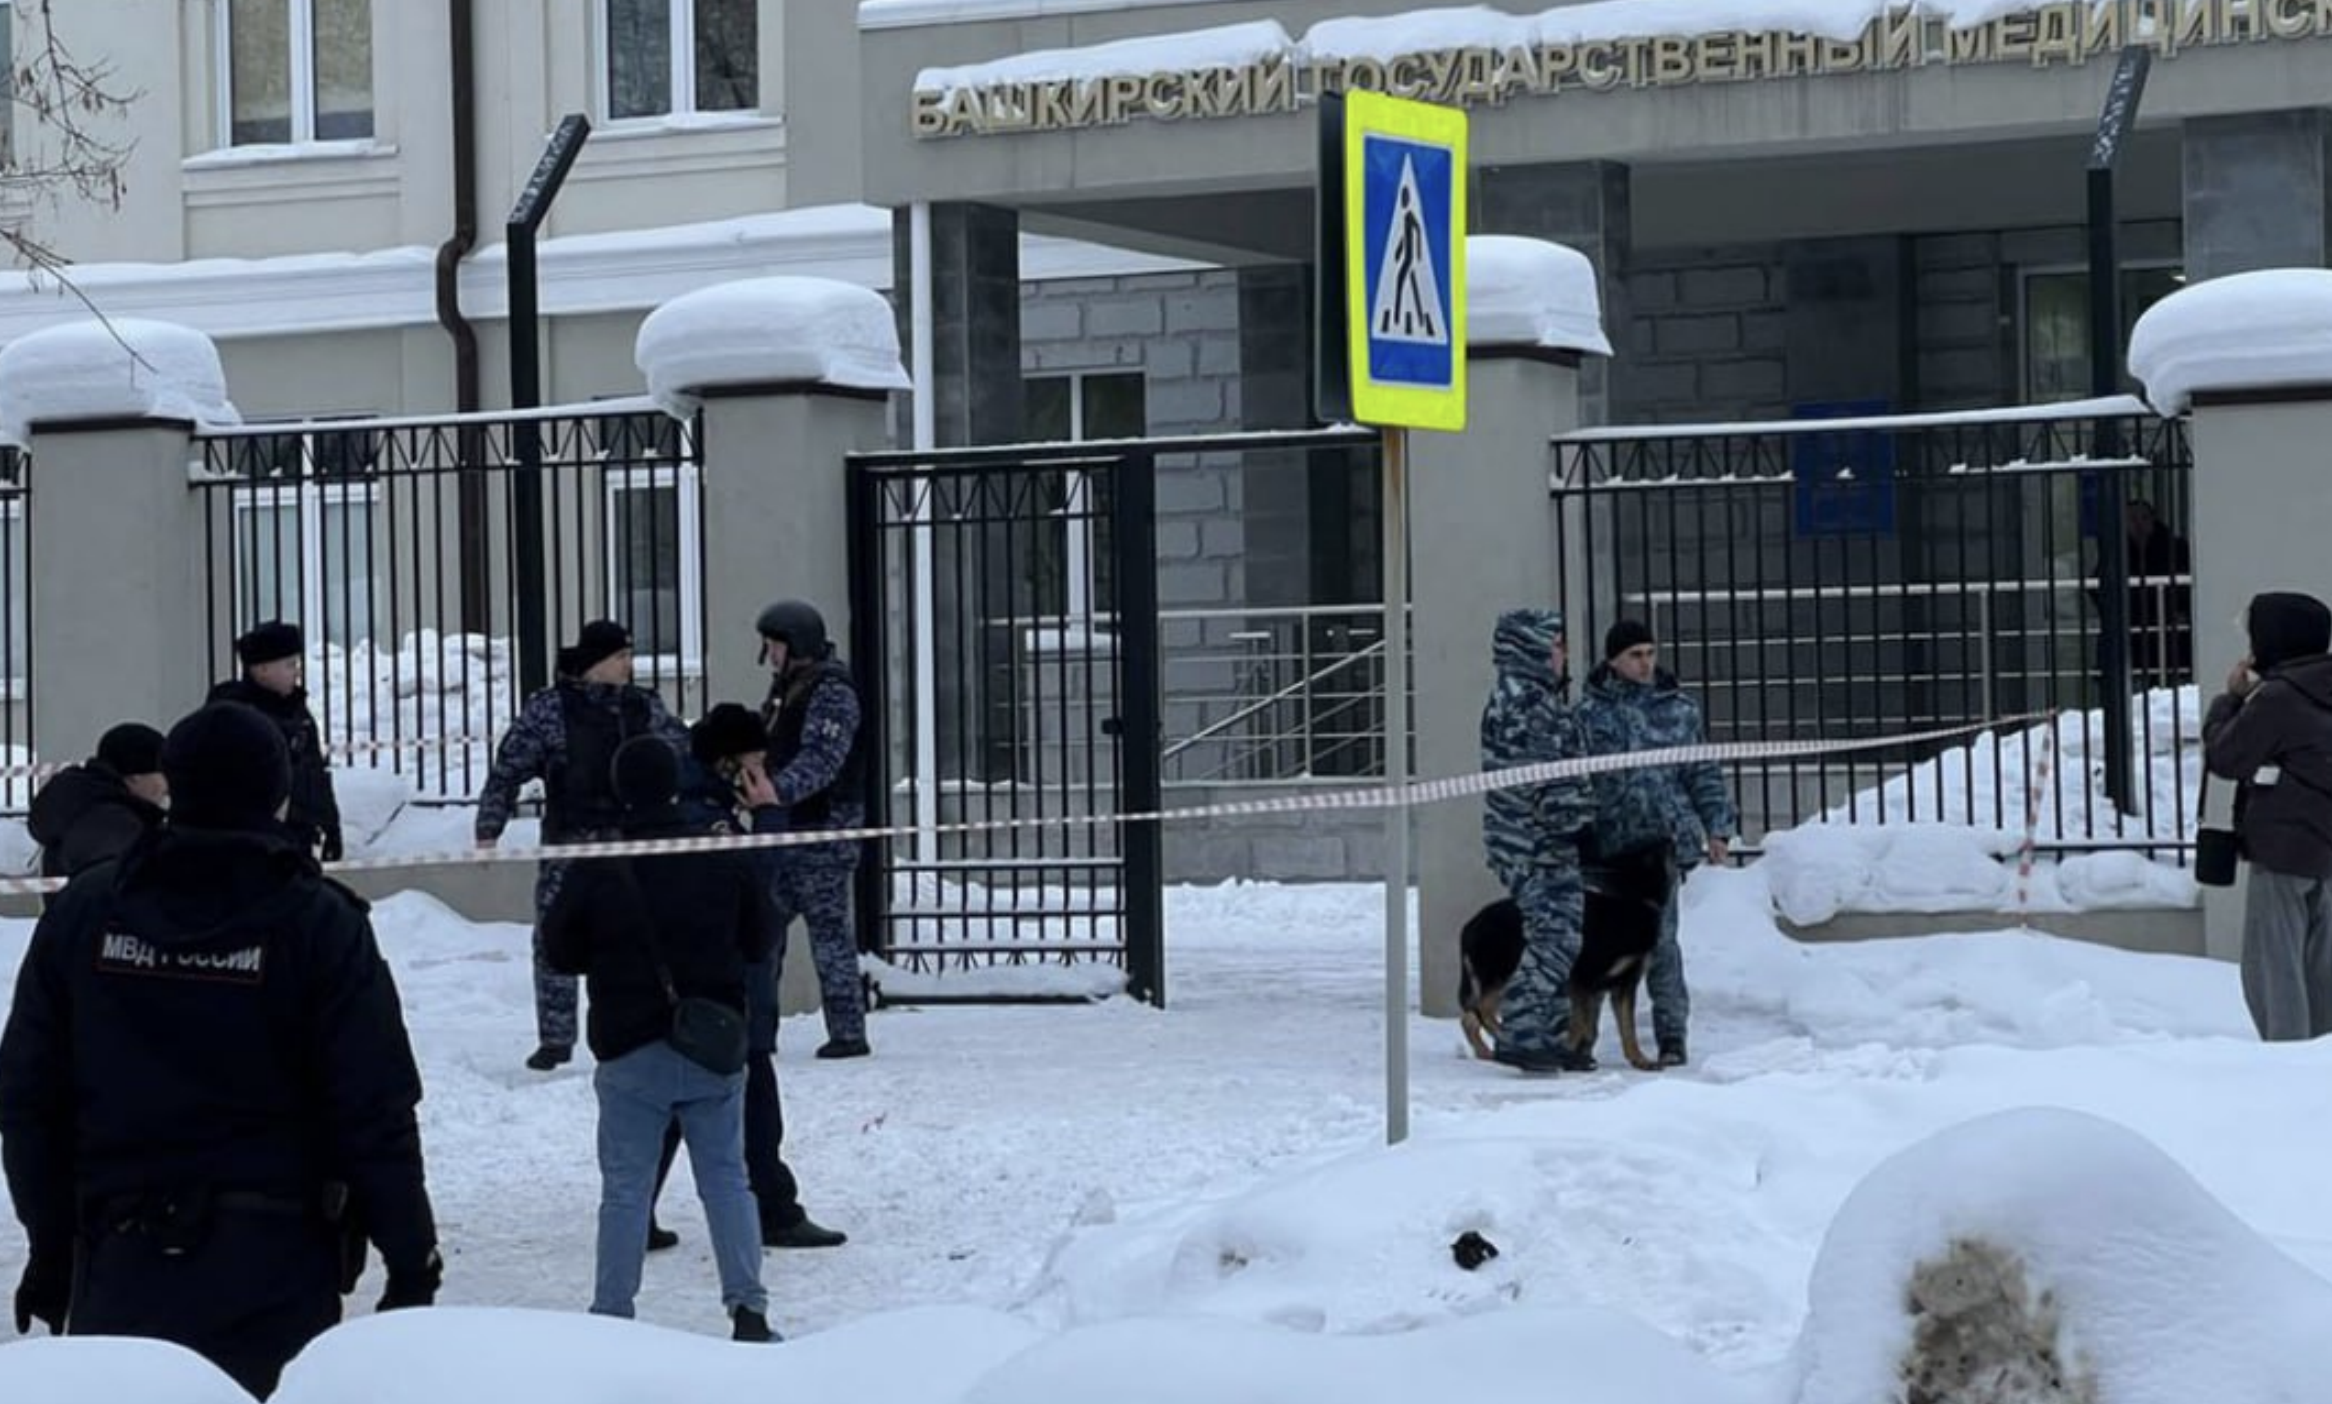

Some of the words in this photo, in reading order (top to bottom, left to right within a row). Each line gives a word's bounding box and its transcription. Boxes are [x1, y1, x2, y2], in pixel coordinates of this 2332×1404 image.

[912, 50, 1298, 139] БАШКИРСКИЙ
[1312, 4, 1926, 109] ГОСУДАРСТВЕННЫЙ
[102, 933, 154, 967] МВД
